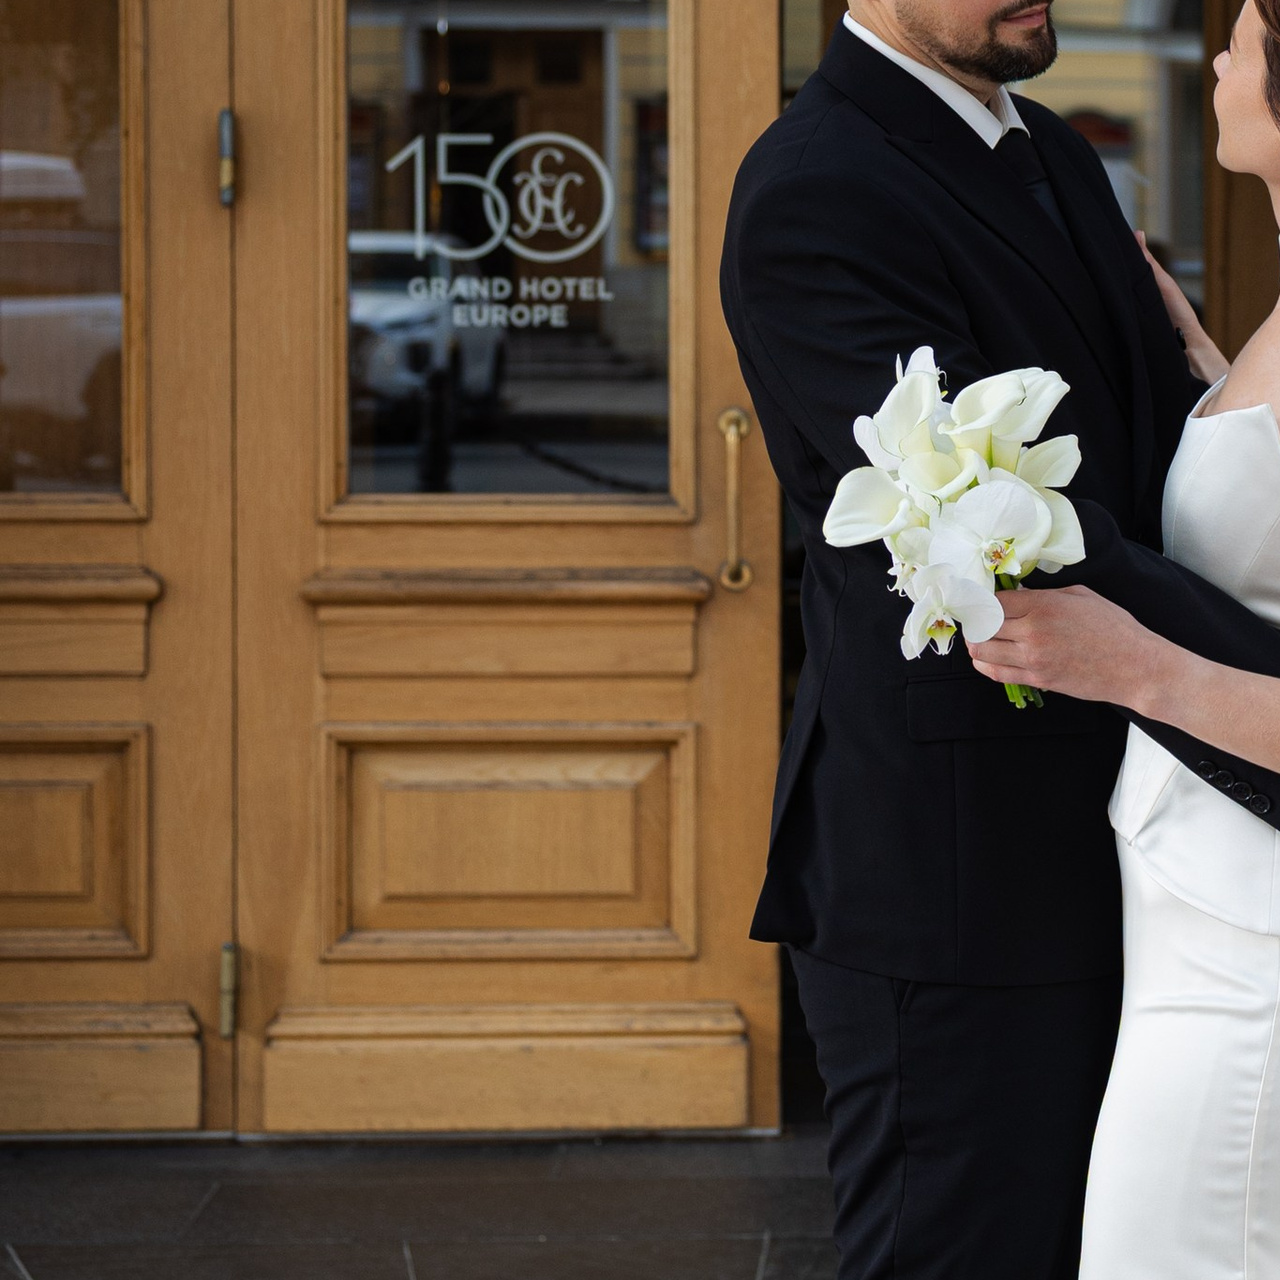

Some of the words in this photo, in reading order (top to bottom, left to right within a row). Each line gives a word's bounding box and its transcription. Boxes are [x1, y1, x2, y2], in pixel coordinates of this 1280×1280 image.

[407, 276, 512, 301] GRAND
[519, 276, 614, 301] HOTEL
[453, 303, 569, 328] EUROPE
